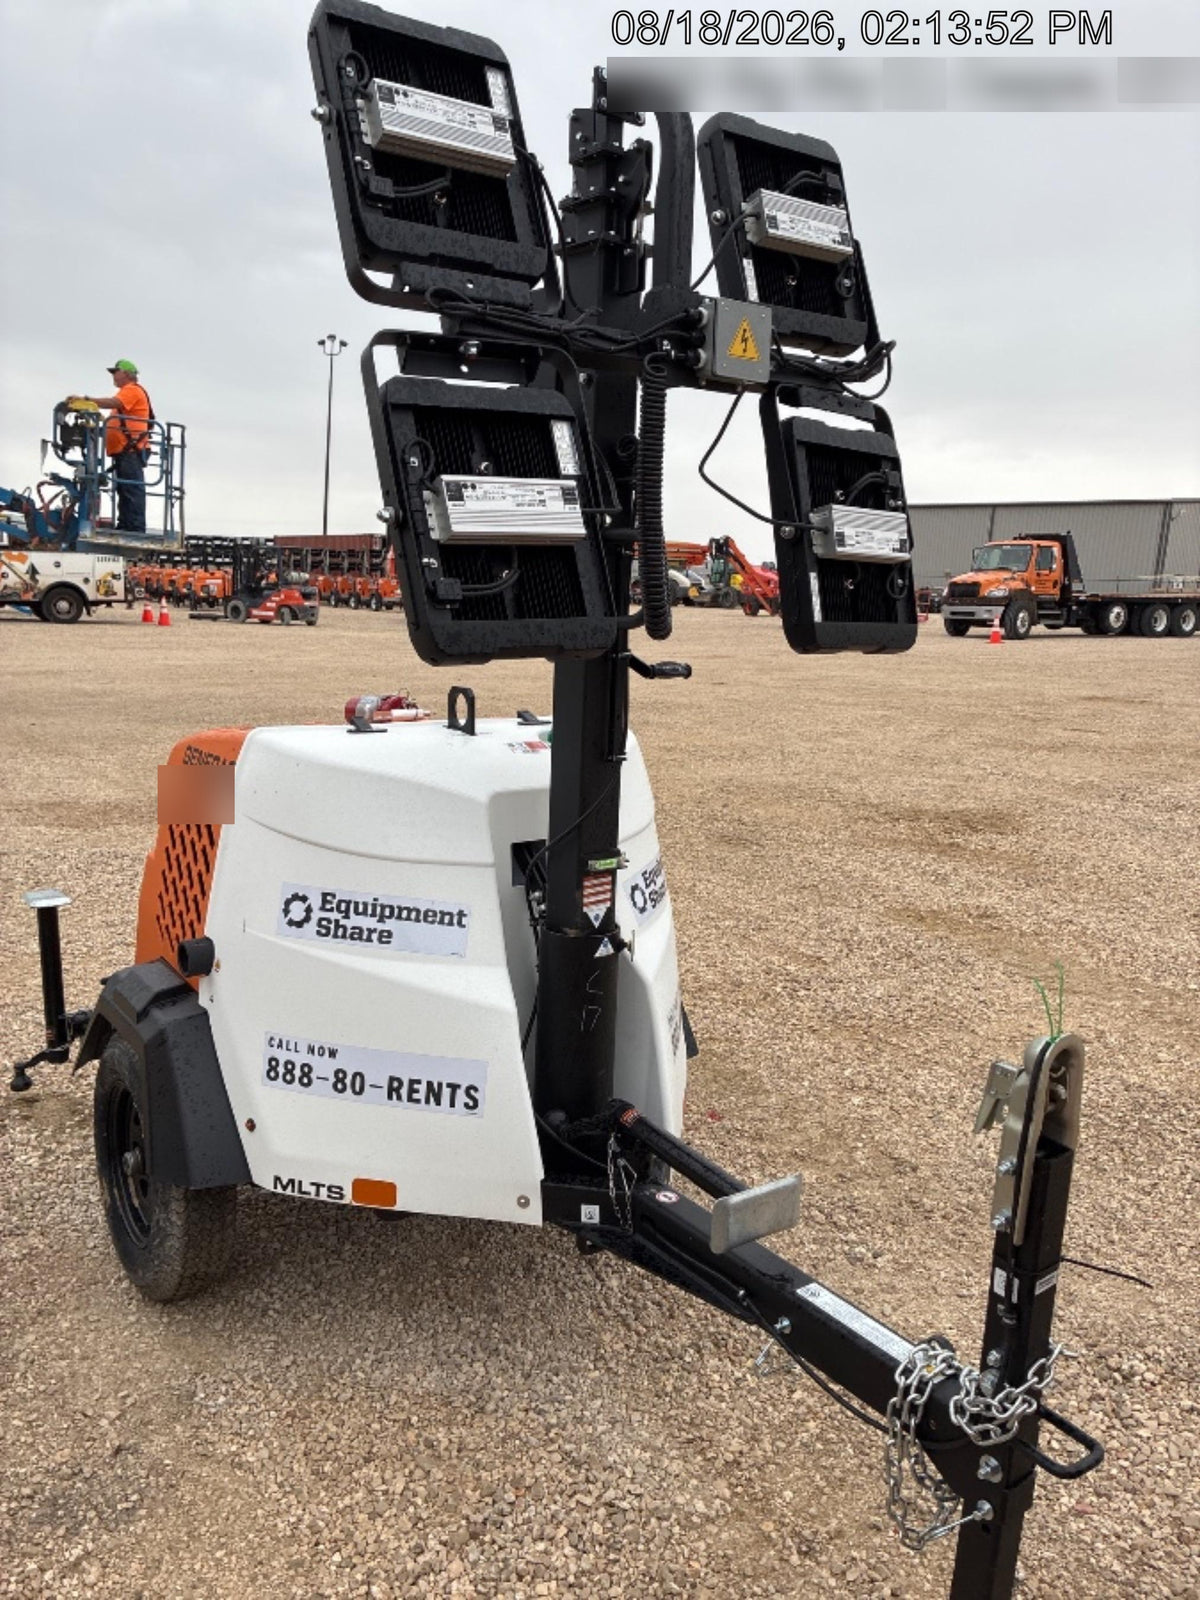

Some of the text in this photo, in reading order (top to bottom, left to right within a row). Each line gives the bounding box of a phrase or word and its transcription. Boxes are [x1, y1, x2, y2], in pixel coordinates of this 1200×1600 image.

[319, 892, 467, 928] Equipment
[316, 917, 393, 944] Share
[267, 1036, 339, 1059] CALL NOW
[266, 1056, 479, 1111] 888-80-RENTS
[273, 1175, 345, 1200] MLTS
